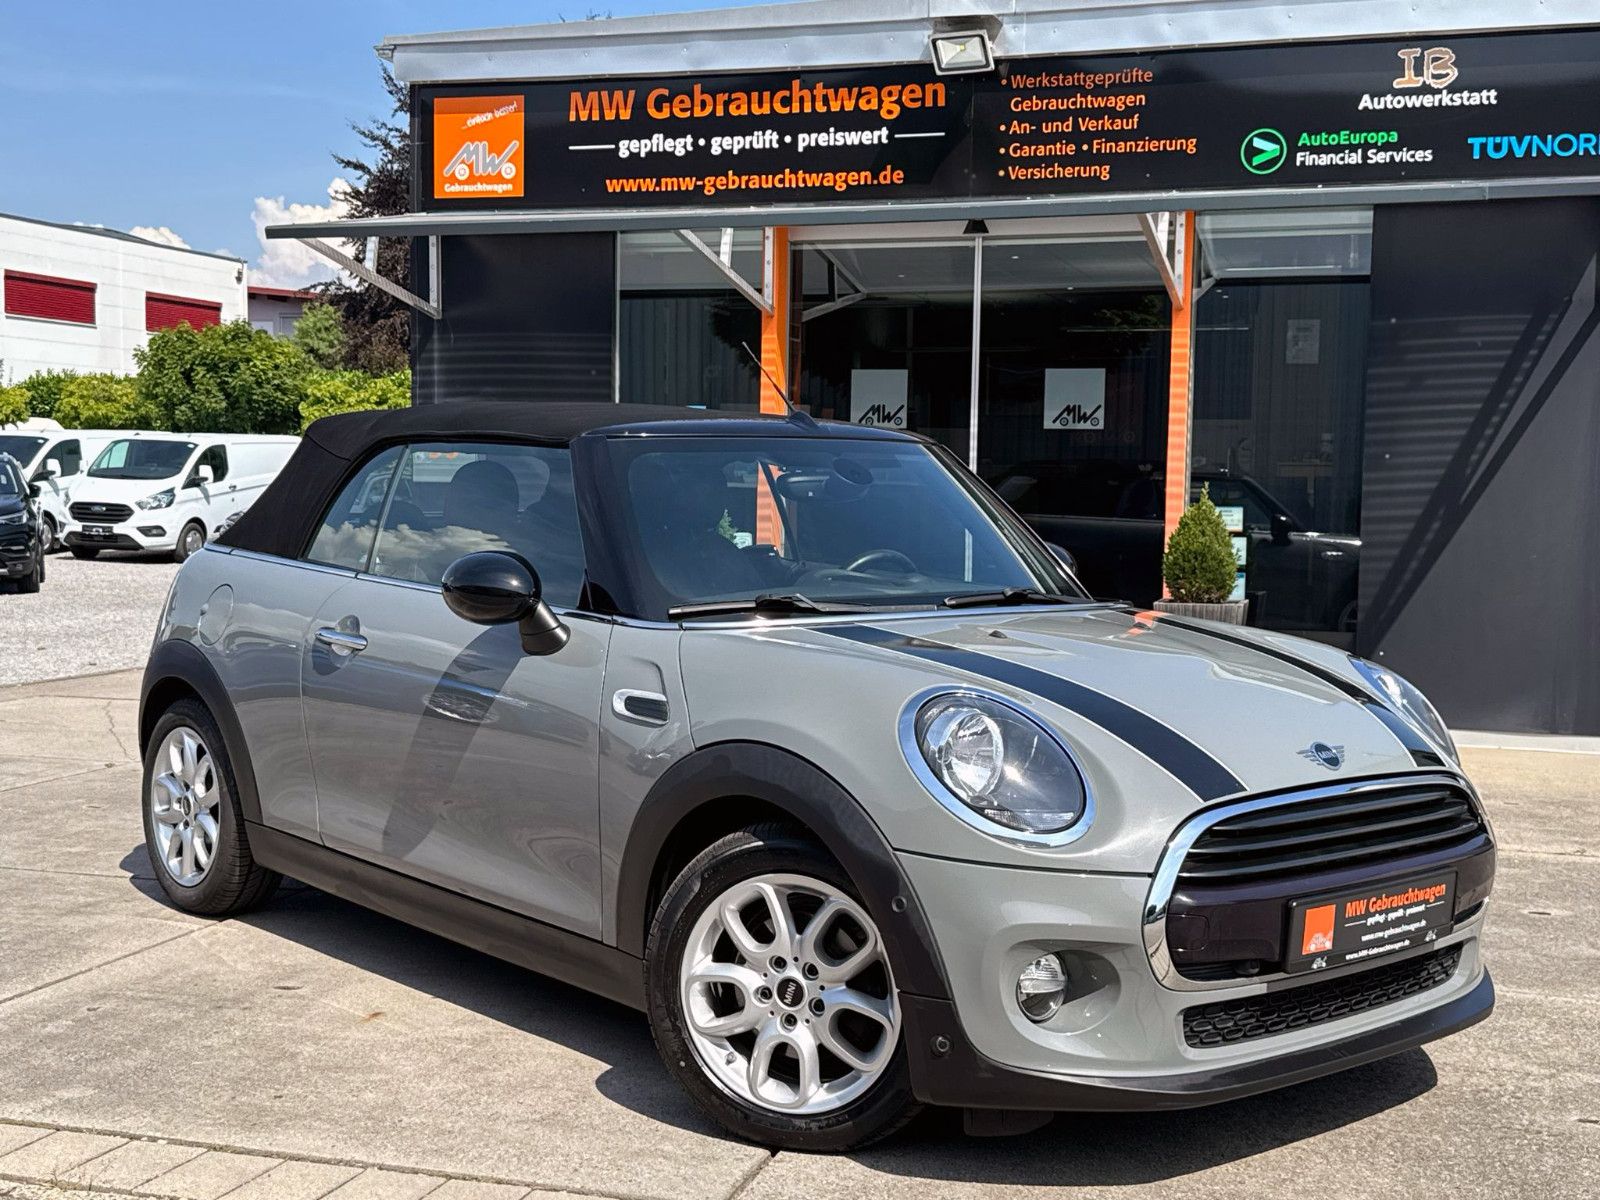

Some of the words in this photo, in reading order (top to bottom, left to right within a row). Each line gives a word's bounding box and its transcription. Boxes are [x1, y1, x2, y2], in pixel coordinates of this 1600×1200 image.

[1011, 68, 1153, 90] Werkstattgeprüfte
[1392, 46, 1459, 89] IB
[569, 89, 636, 122] MW
[647, 80, 946, 120] Gebrauchtwagen
[1010, 92, 1146, 112] Gebrauchtwagen
[1357, 88, 1498, 111] Autowerkstatt
[1009, 117, 1037, 135] An-
[1042, 116, 1073, 133] und
[1078, 113, 1139, 131] Verkauf
[618, 134, 693, 158] gepflegt
[710, 130, 779, 155] geprüft
[797, 127, 889, 152] preiswert
[1009, 139, 1076, 158] Garantie
[1092, 135, 1197, 158] Finanzierung
[1297, 128, 1398, 147] AutoEuropa
[1467, 132, 1600, 159] TÜVNOR
[1296, 148, 1363, 167] Financial
[1367, 145, 1433, 165] Services
[606, 165, 905, 196] www.mw-gebrauchtwagen.de
[1008, 160, 1111, 181] Versicherung
[444, 182, 513, 193] Gebrauchtwagen
[1346, 900, 1367, 919] MW
[1369, 884, 1446, 913] Gebrauchtwagen
[784, 982, 797, 1005] MINI
